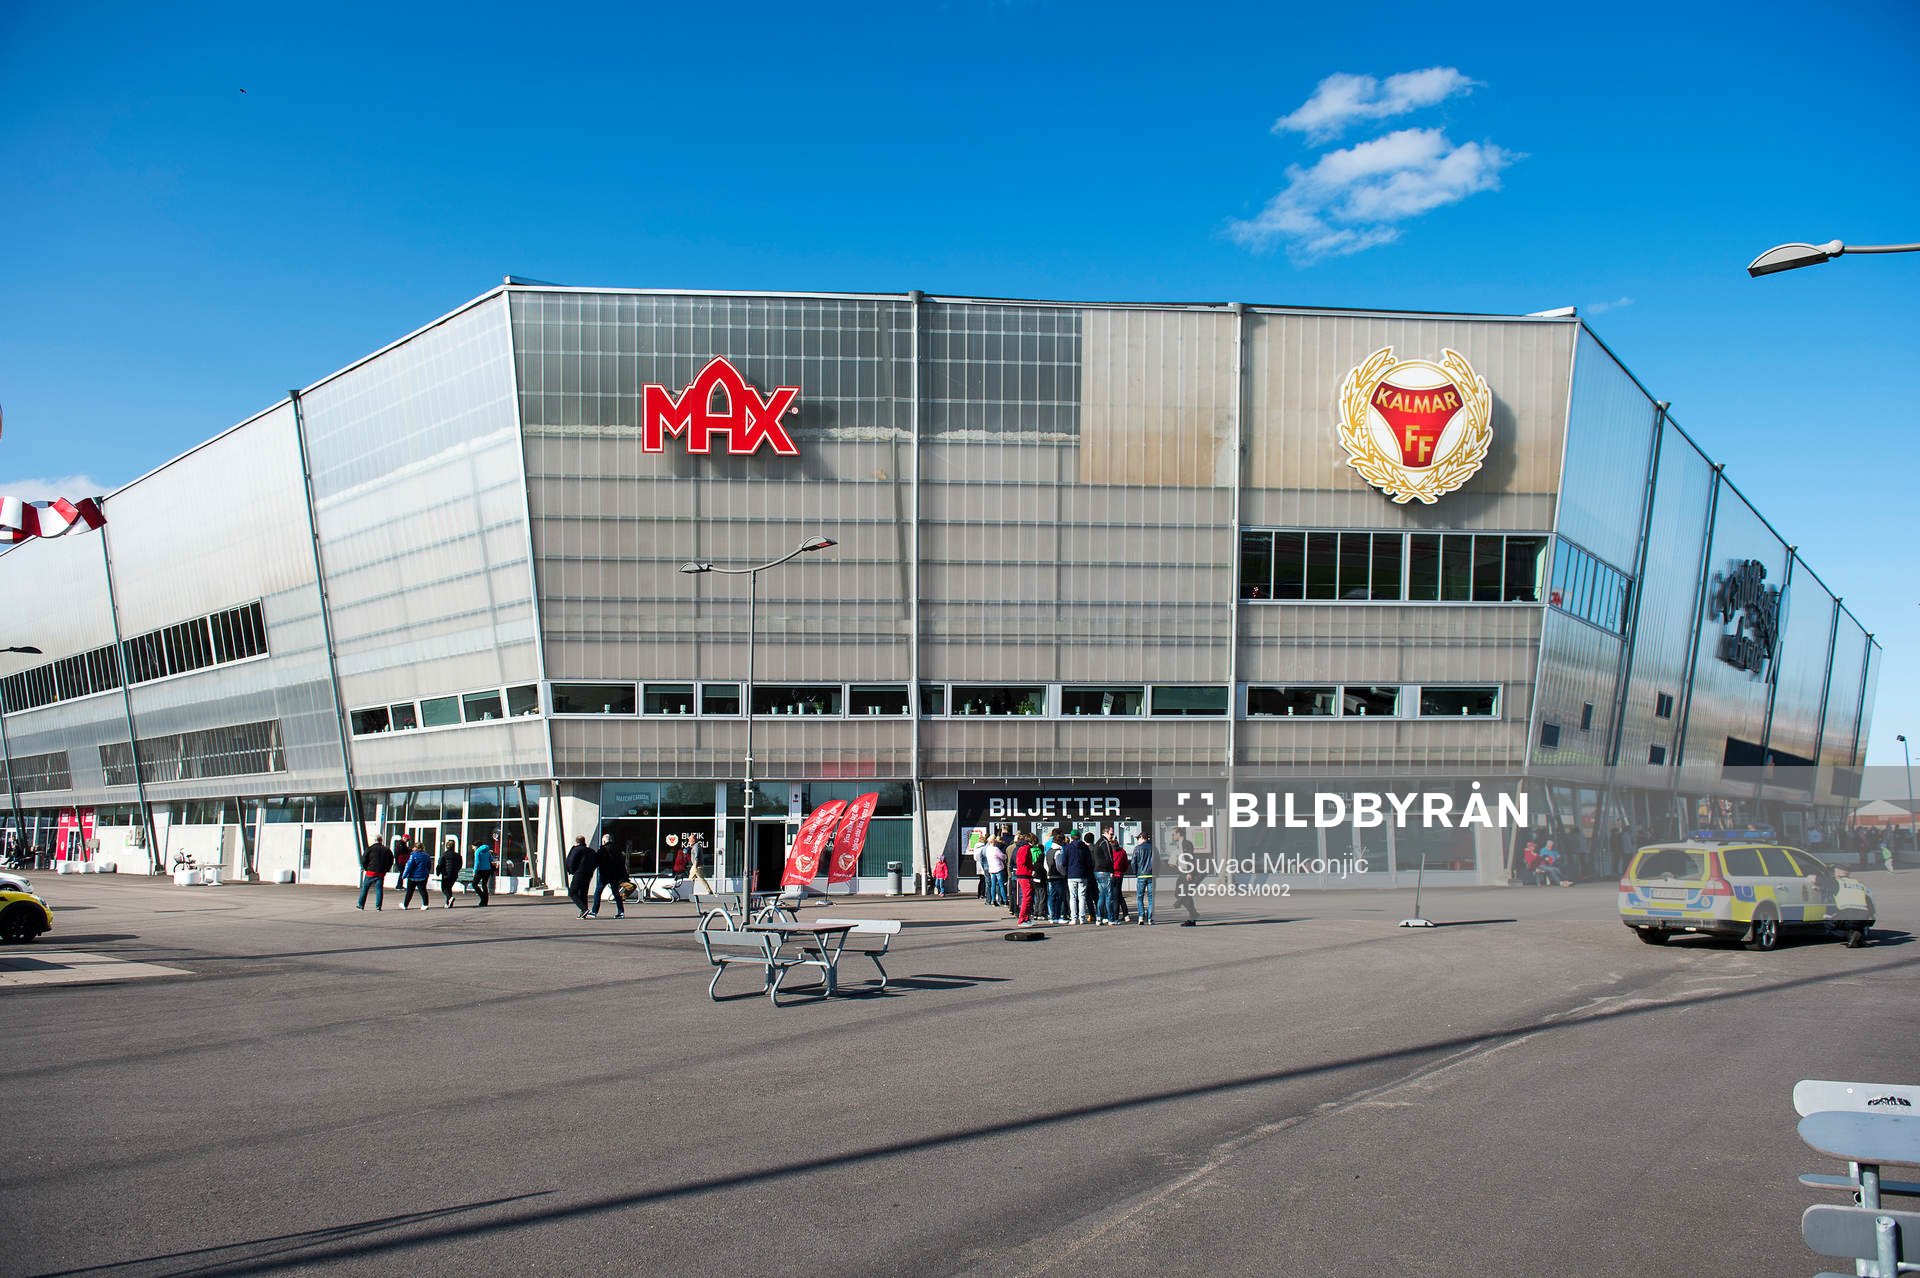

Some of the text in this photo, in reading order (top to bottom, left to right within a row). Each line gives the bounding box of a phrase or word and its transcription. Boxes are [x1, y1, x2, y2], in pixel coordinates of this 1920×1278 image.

[642, 354, 801, 456] MAX
[1376, 387, 1459, 413] KALMAR
[1405, 425, 1433, 462] FF
[989, 798, 1120, 817] BILJETTER
